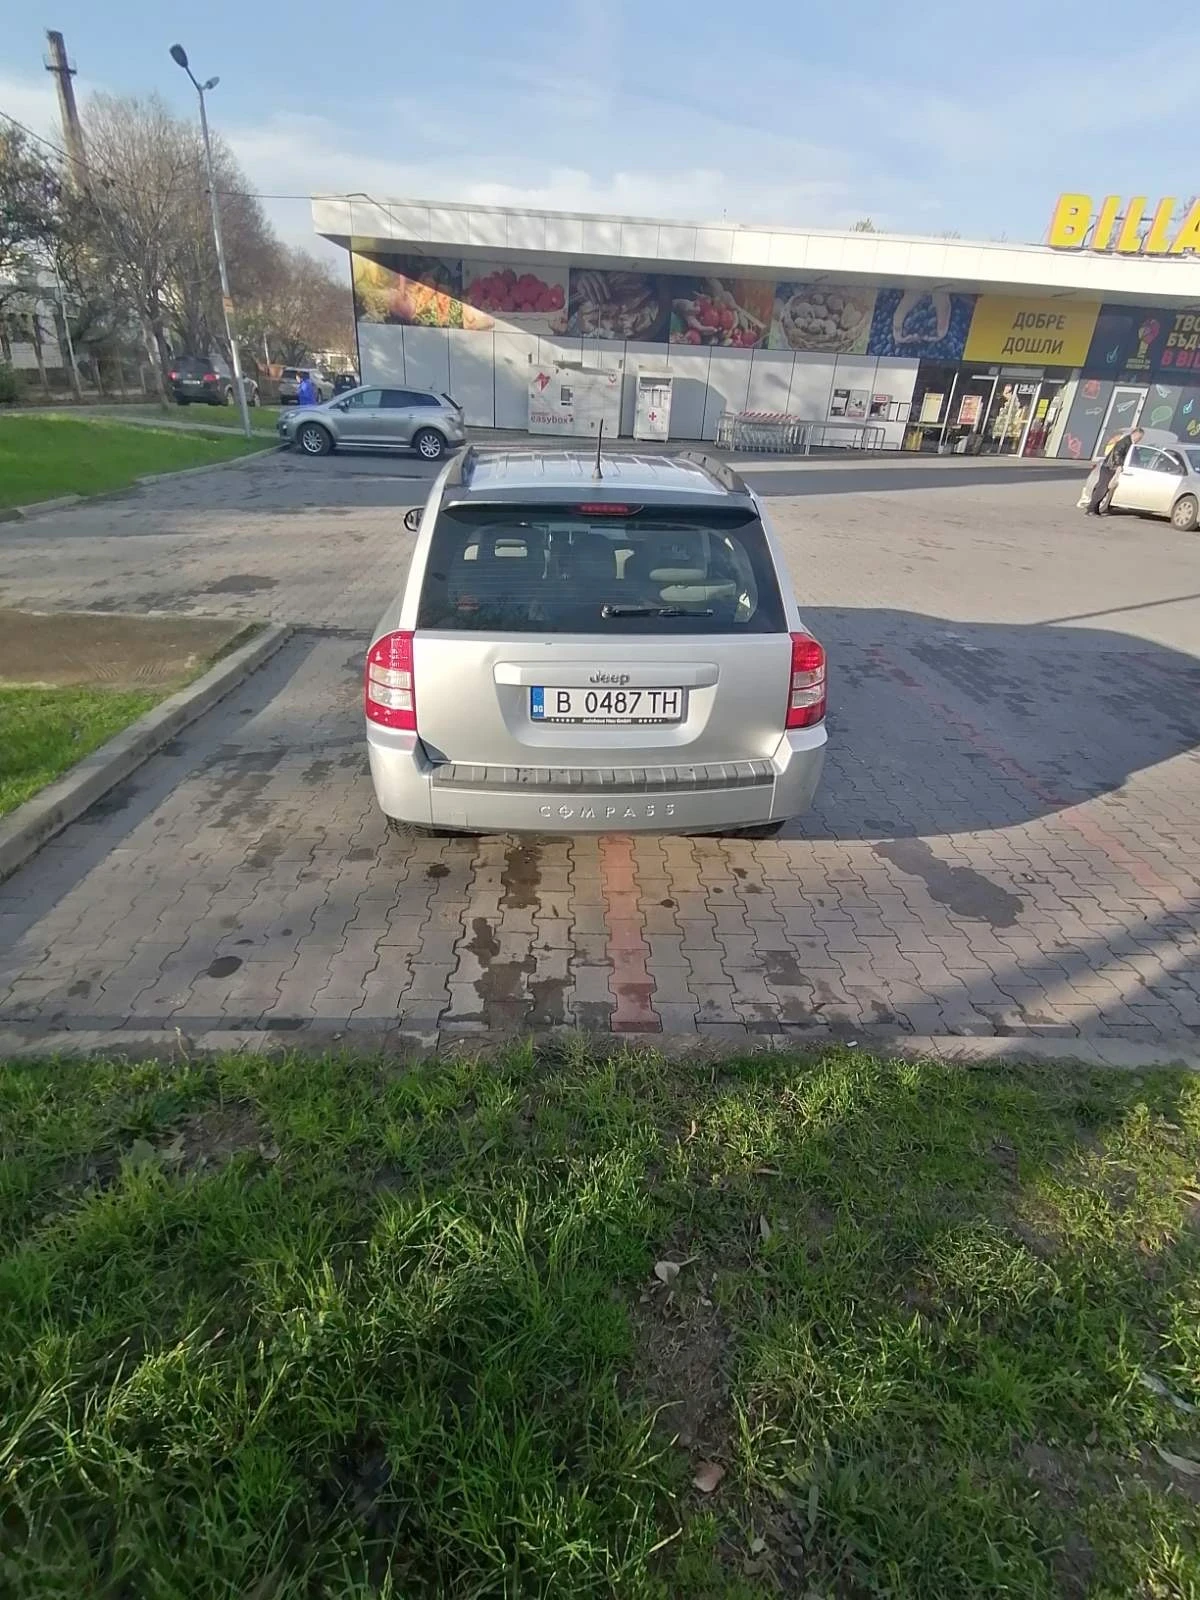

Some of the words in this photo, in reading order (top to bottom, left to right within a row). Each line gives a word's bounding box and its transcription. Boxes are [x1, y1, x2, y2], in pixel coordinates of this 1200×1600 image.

[1012, 311, 1067, 331] ДОБРЕ
[1001, 336, 1064, 355] ДОШЛИ
[530, 415, 568, 425] easybox
[589, 670, 631, 686] Jeep
[533, 704, 544, 713] BG
[556, 691, 571, 713] B
[585, 691, 642, 713] 0487
[648, 691, 677, 713] TH
[538, 803, 675, 819] COMPASS
